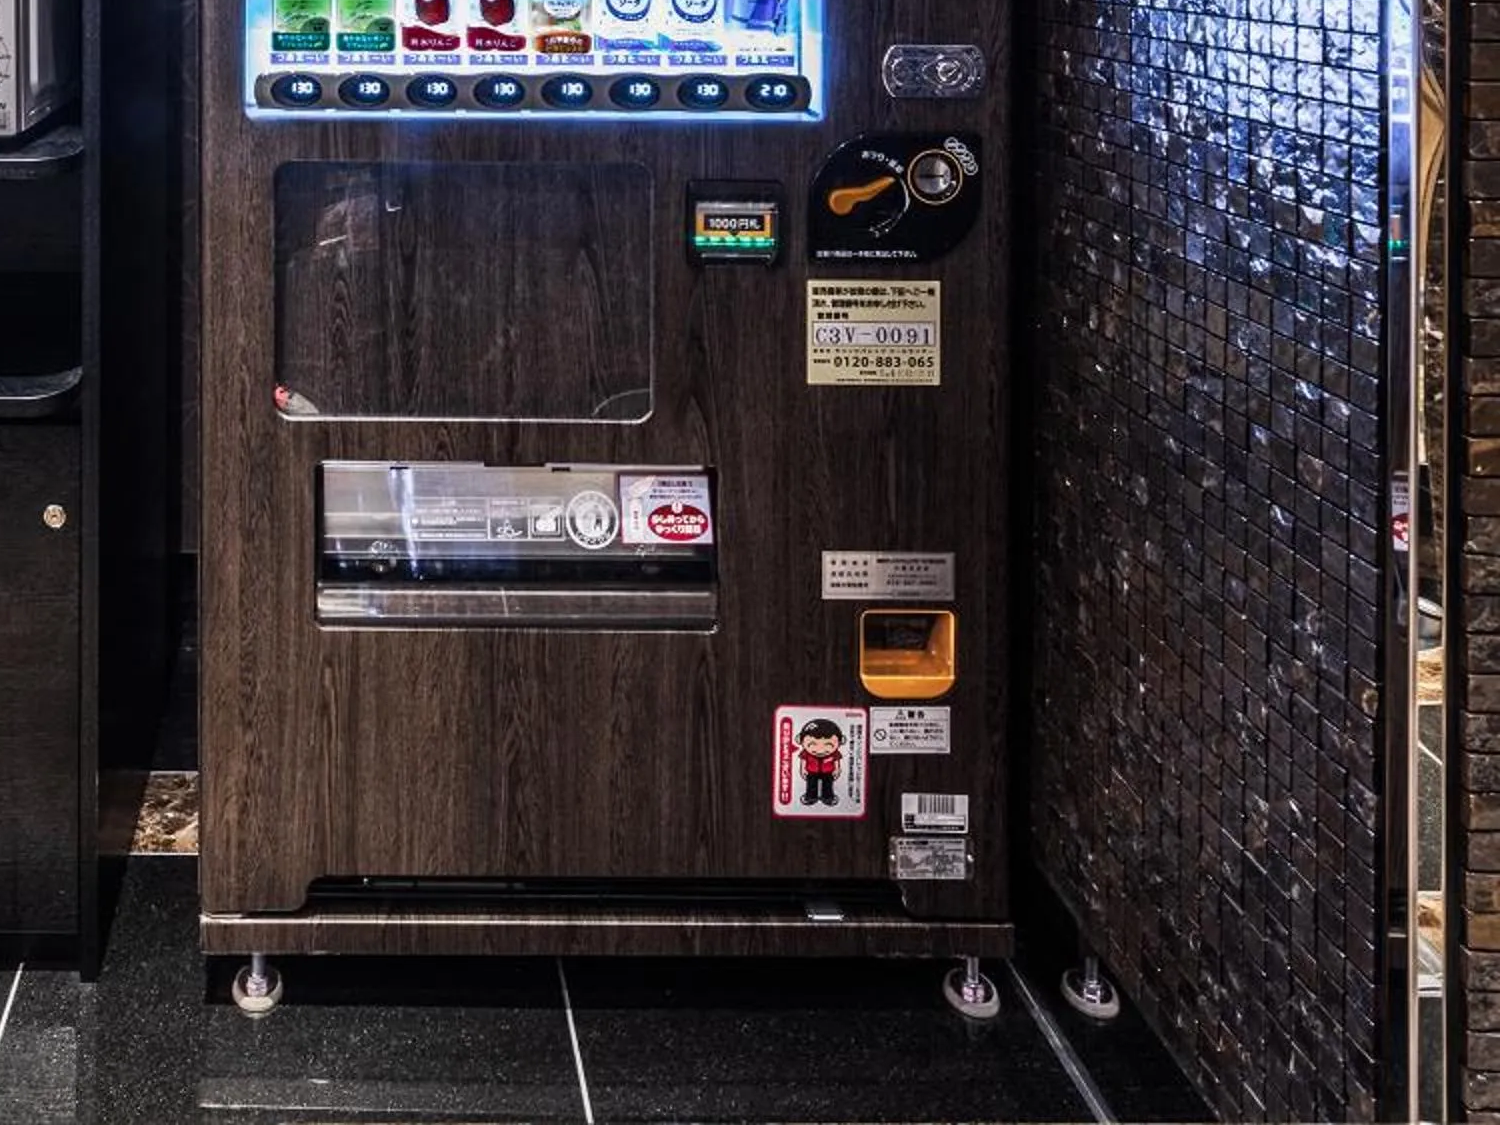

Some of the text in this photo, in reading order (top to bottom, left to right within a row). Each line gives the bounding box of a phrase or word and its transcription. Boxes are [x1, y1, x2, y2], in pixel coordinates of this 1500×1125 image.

[291, 83, 313, 95] 130
[359, 83, 381, 95] 130
[426, 83, 448, 95] 130
[494, 83, 516, 95] 130
[562, 83, 583, 95] 130
[629, 83, 651, 95] 130
[697, 83, 719, 95] 130
[759, 83, 788, 95] 210
[708, 218, 761, 229] 1000円札
[815, 326, 930, 344] C3V-0091
[833, 356, 934, 367] 0120-883-065
